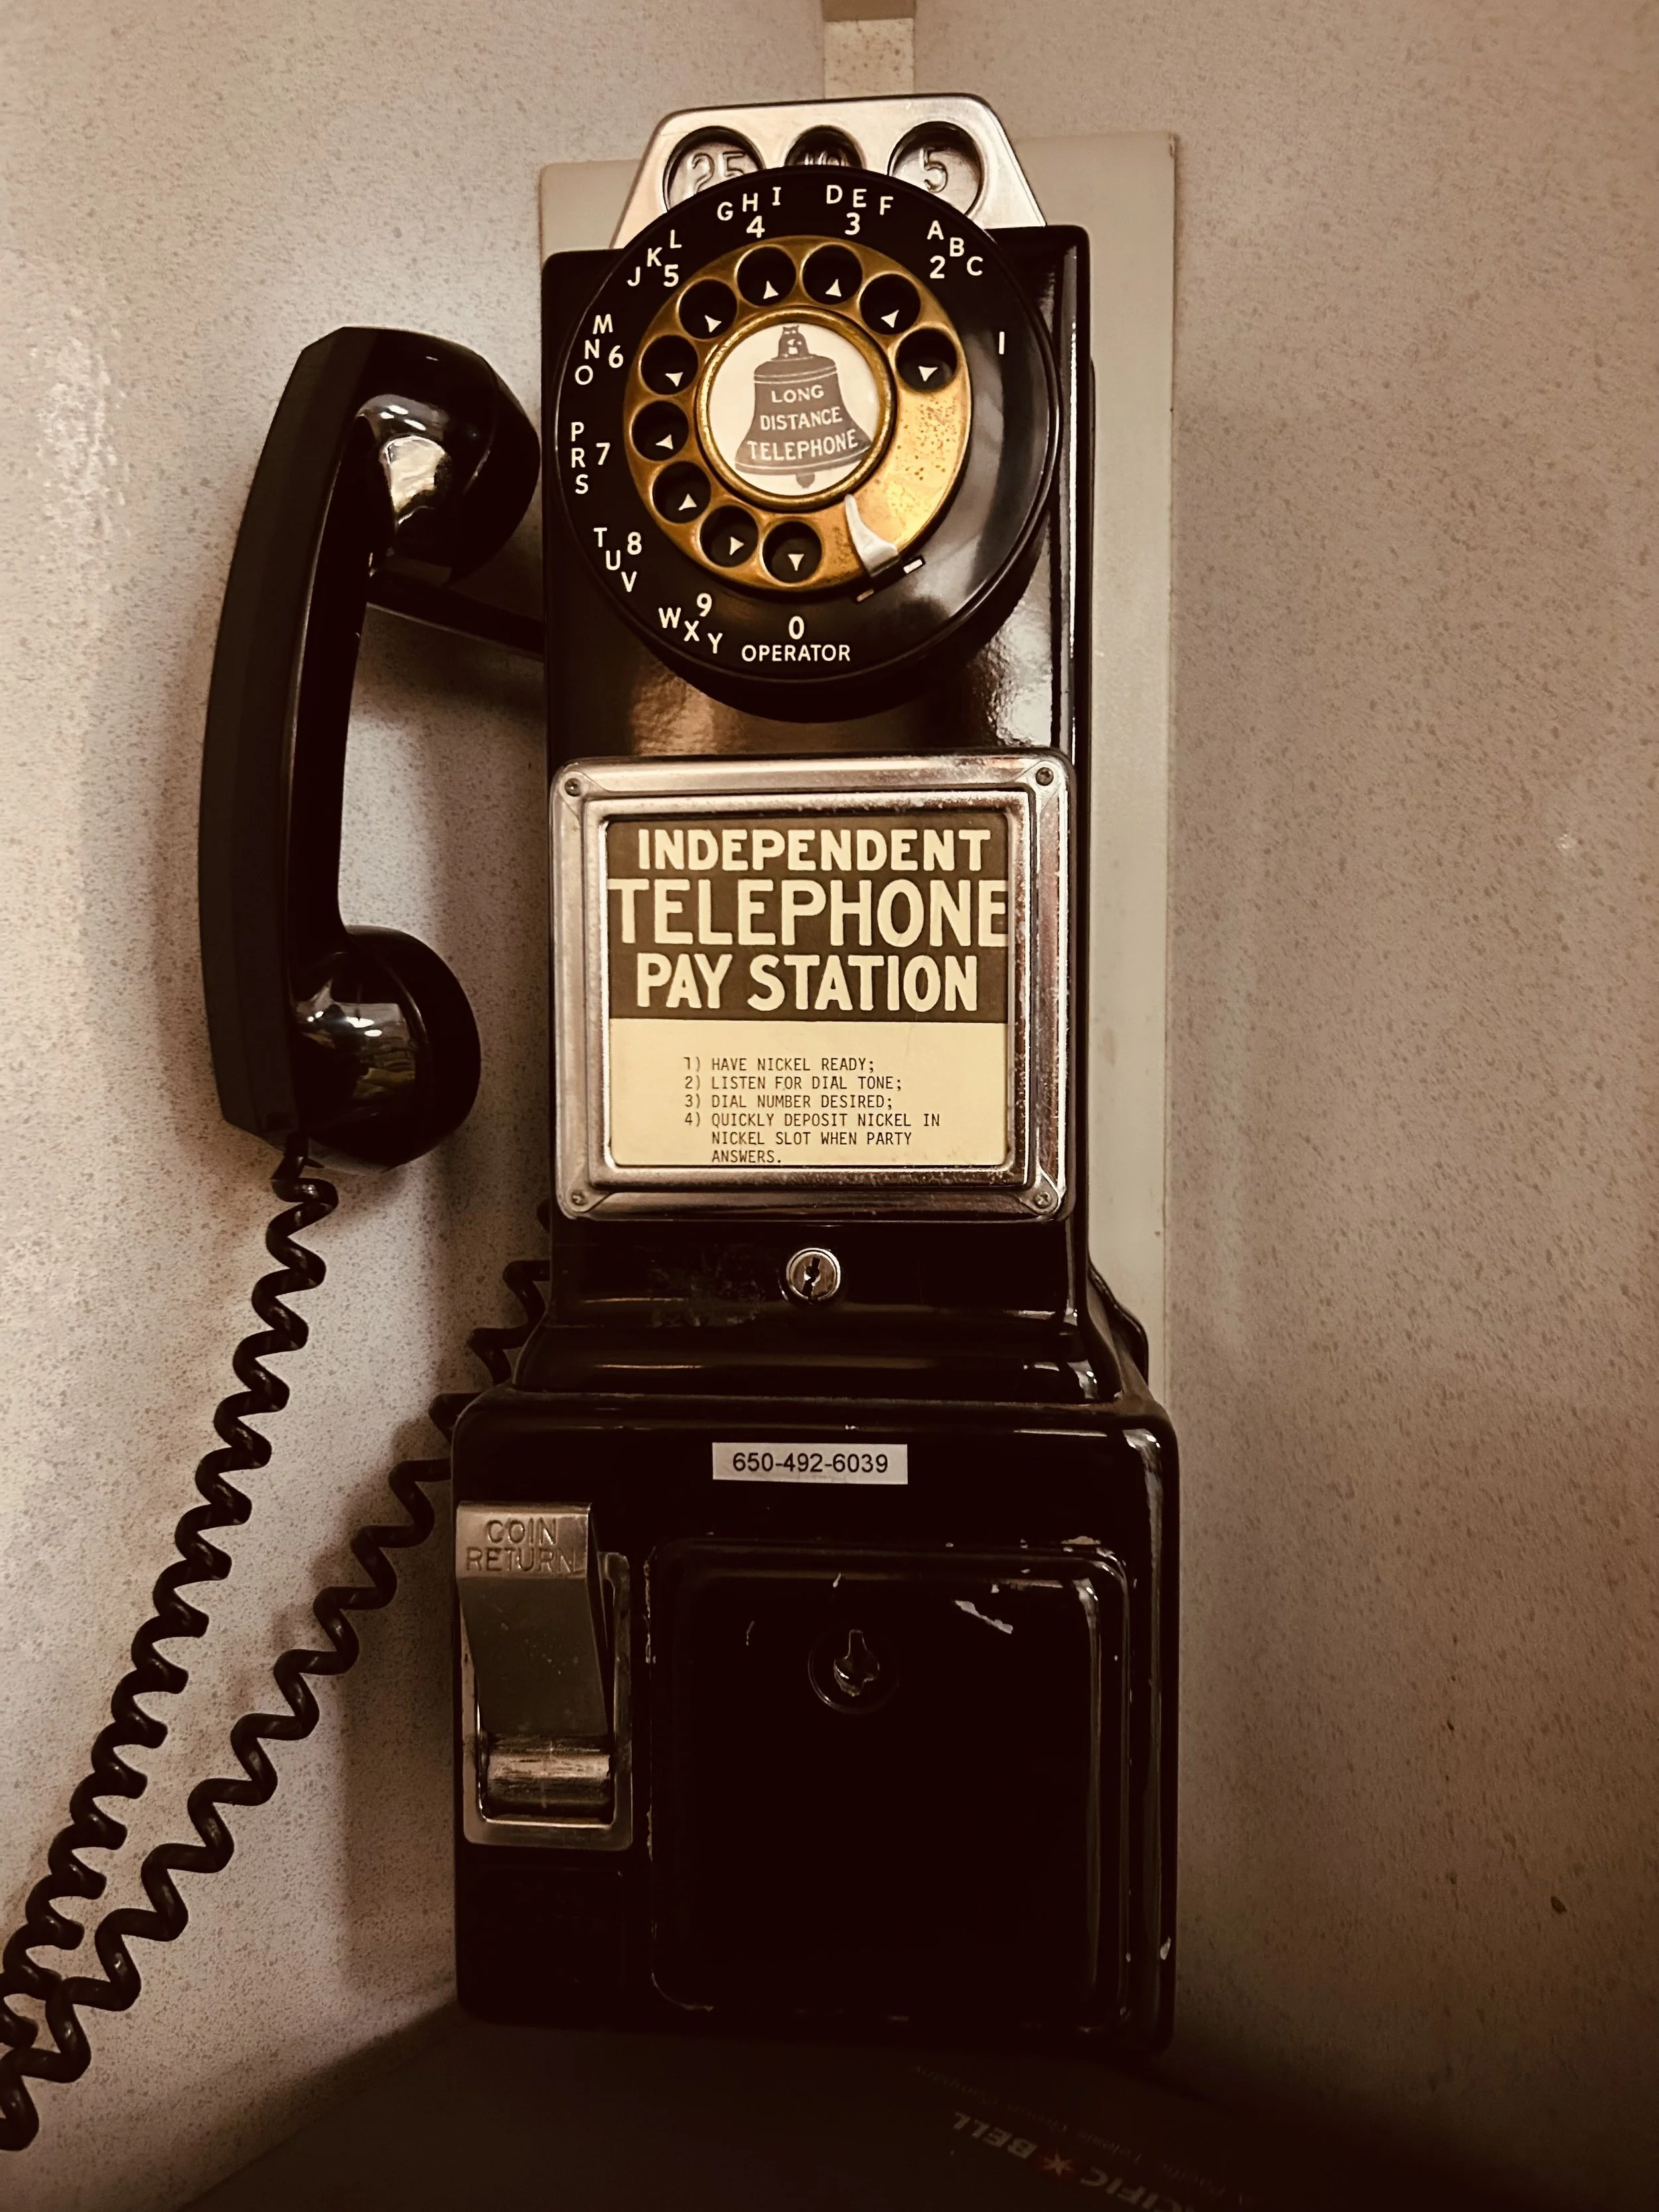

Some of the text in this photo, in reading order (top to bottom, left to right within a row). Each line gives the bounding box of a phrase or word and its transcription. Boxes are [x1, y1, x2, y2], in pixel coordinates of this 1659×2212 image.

[920, 145, 948, 192] 5
[746, 215, 765, 238] 4
[844, 212, 860, 236] 3
[664, 263, 679, 287] 5
[930, 255, 946, 279] 2
[609, 345, 624, 368] 6
[771, 384, 824, 403] LONG
[760, 406, 843, 431] DISTANCE
[596, 442, 611, 465] 7
[747, 429, 859, 461] TELEPHONE
[627, 531, 642, 555] 8
[696, 593, 712, 617] 9
[741, 644, 851, 662] OPERATOR
[637, 829, 991, 871] INDEPENDENT
[607, 878, 1008, 948] TELEPHONE
[636, 952, 977, 1012] PAY STATION
[684, 1057, 875, 1073] 1) HAVE NICKEL READY;
[685, 1076, 902, 1092] 2) LISTEN FOR DIAL TONE;
[685, 1094, 893, 1110] 3) DIAL NUMBER DESIRED;
[685, 1112, 940, 1128] 4) QUICKLY DEPOSIT NICKEL IN
[712, 1131, 912, 1145] NICKEL SLOT WHEN PARTY
[711, 1149, 782, 1163] ANSWERS.
[732, 1452, 889, 1474] 650-492-6039
[486, 1517, 558, 1544] COIN
[466, 1546, 576, 1574] RETURN
[952, 2110, 1038, 2159] BELL
[1080, 2167, 1194, 2212] CIFIC
